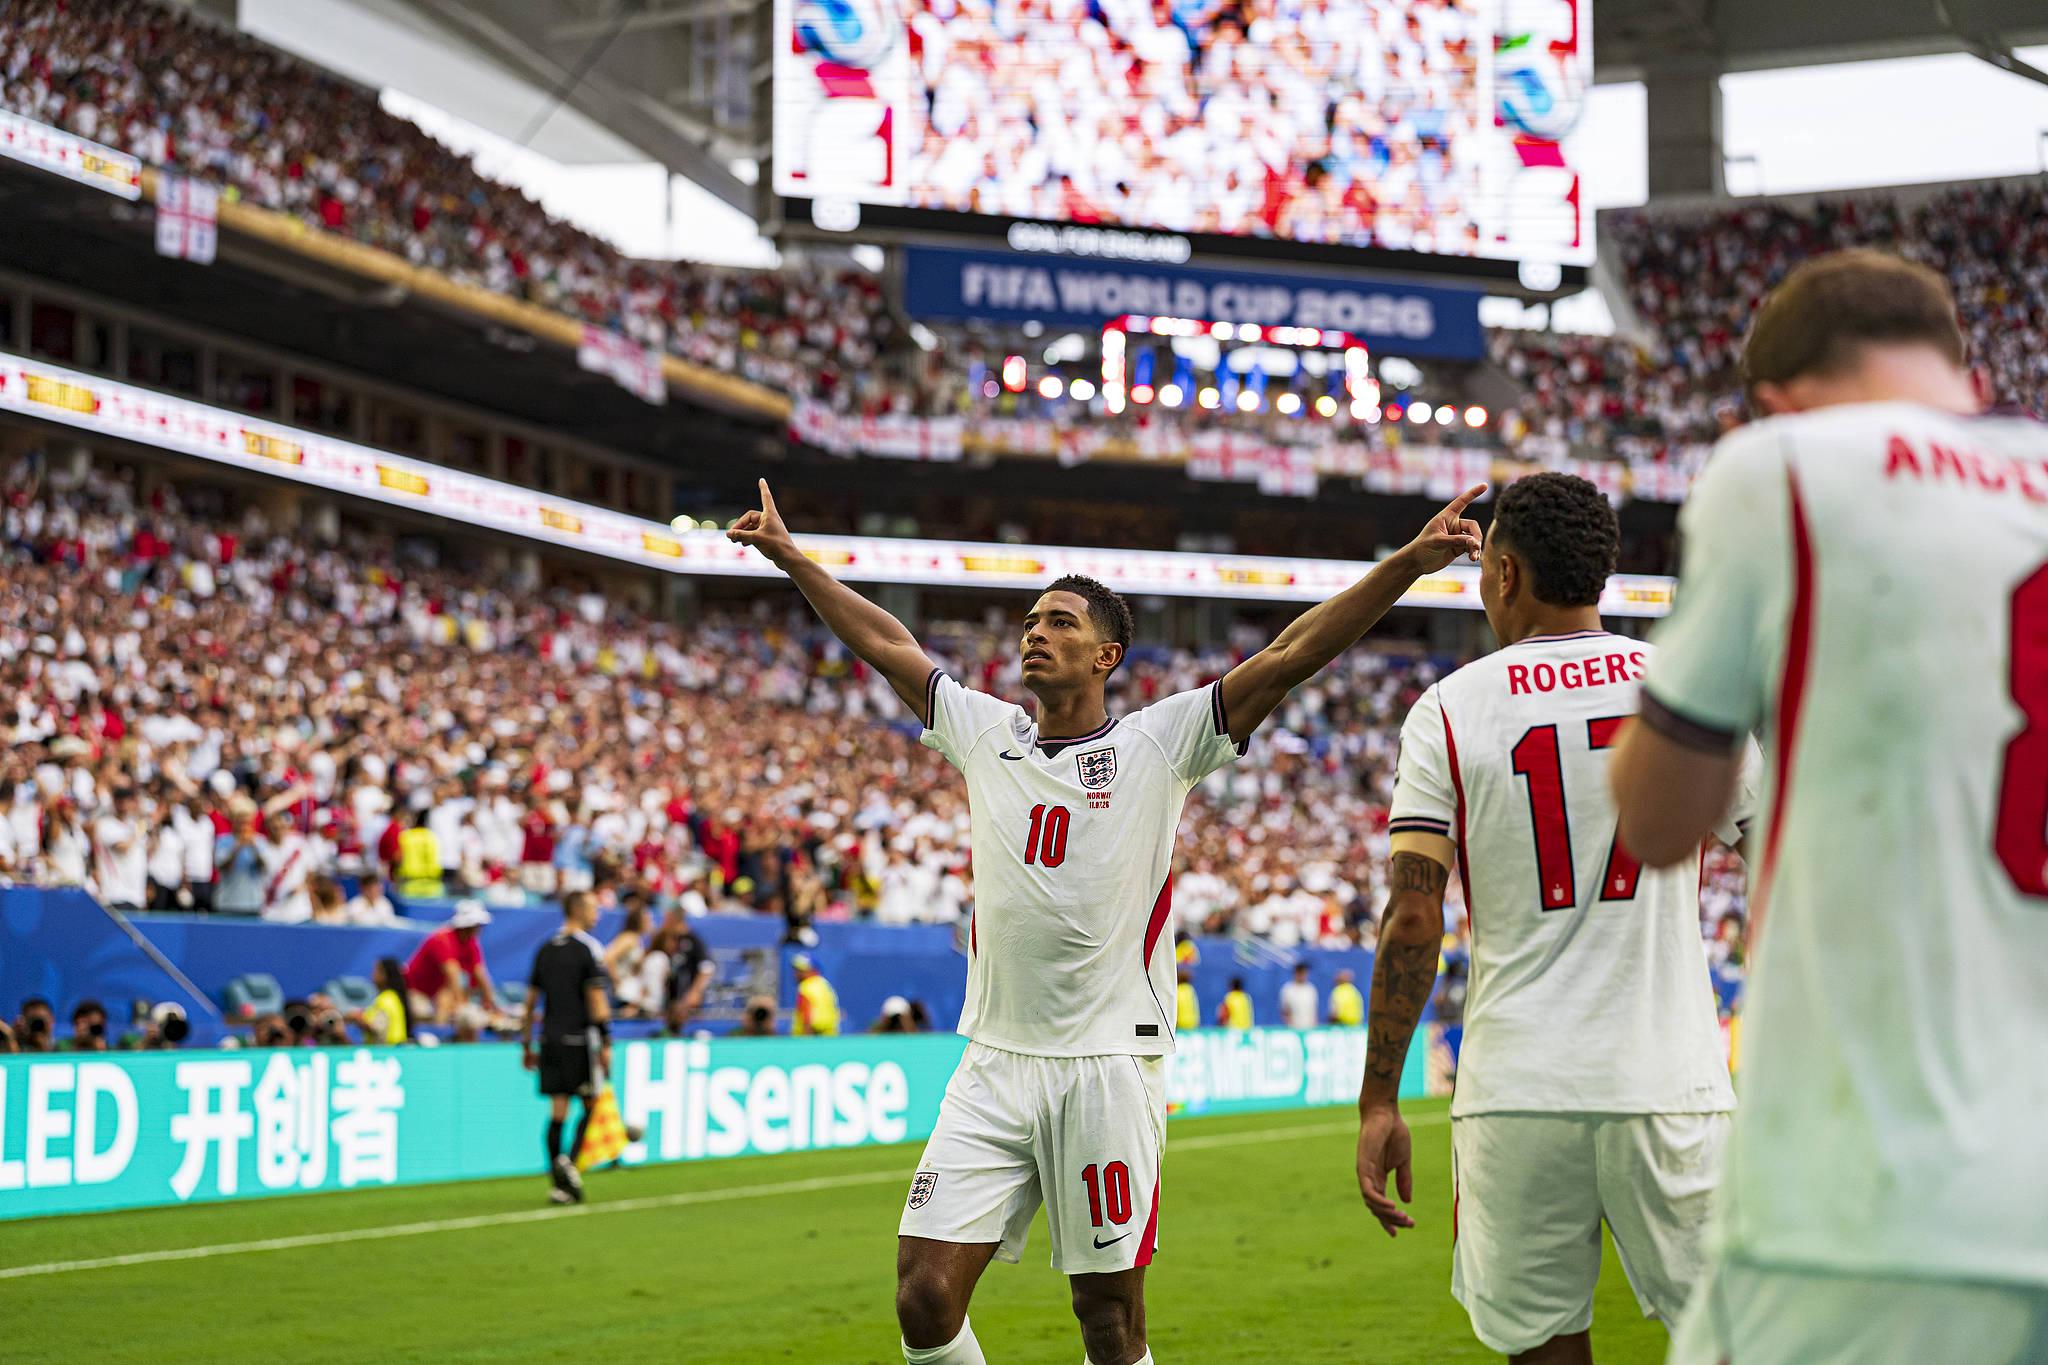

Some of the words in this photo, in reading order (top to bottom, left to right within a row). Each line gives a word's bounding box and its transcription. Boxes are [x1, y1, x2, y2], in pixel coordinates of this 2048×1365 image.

[961, 264, 1056, 312] FIFA
[1057, 270, 1206, 318] WORLD
[1211, 282, 1292, 322] CUP
[1294, 288, 1435, 338] 2026
[1507, 652, 1647, 695] ROGERS
[1025, 803, 1071, 867] 10
[169, 1050, 405, 1200] 开创者
[622, 1040, 909, 1163] Hisense
[1081, 1160, 1133, 1227] 10
